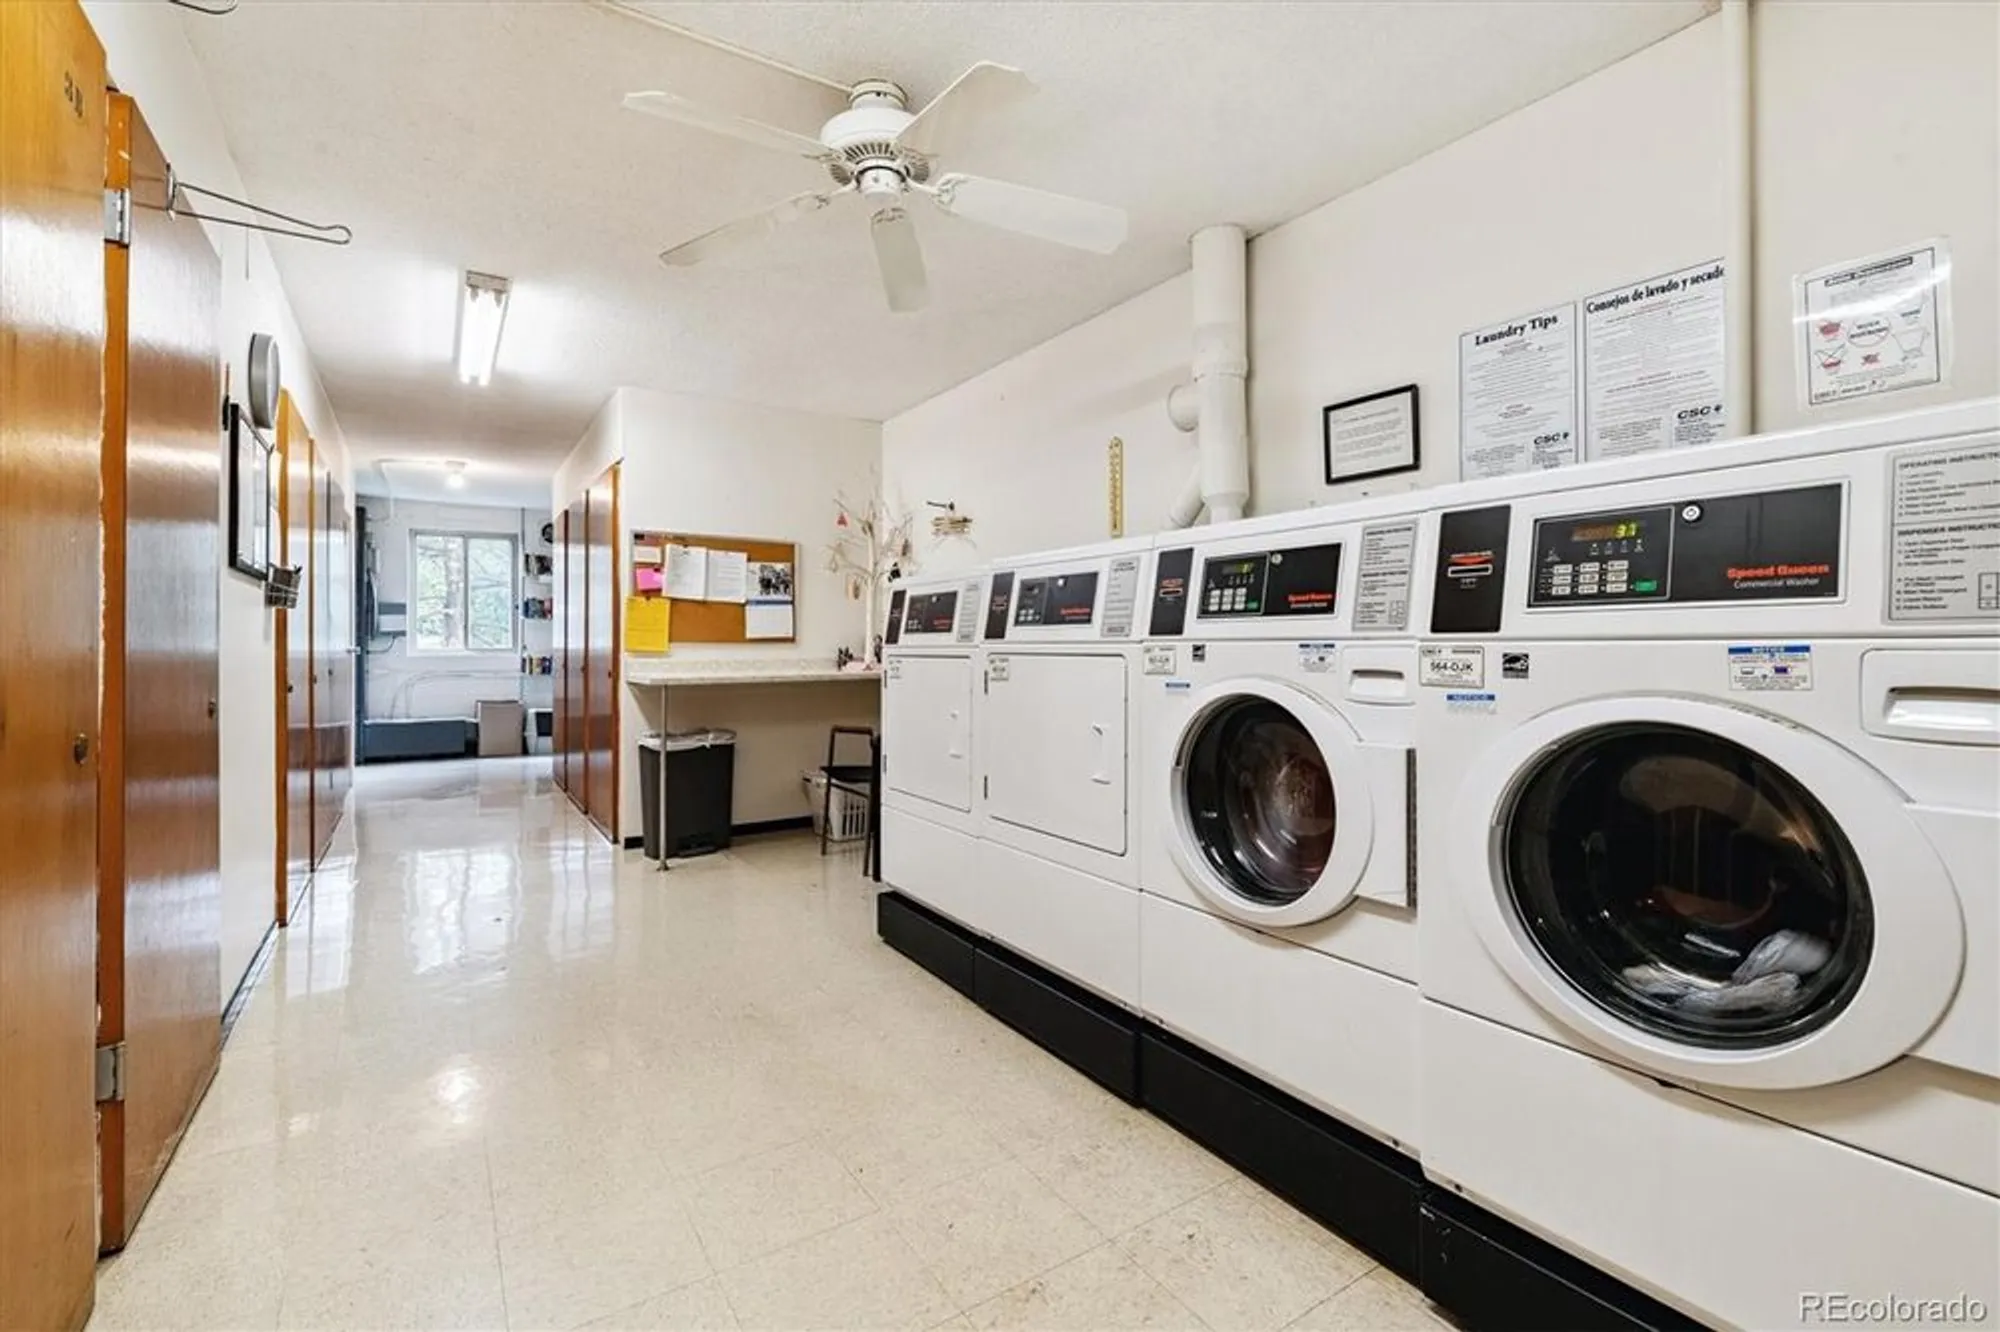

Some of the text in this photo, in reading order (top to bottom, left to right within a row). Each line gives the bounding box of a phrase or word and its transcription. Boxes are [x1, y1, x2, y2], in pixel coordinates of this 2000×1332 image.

[1586, 294, 1630, 314] Consejos
[1631, 290, 1644, 302] de
[1645, 280, 1680, 299] lavado
[1680, 278, 1688, 291] y
[1475, 314, 1558, 346] Laundry Tips
[1677, 405, 1710, 420] CSC
[1534, 432, 1561, 446] CSC
[1727, 564, 1830, 580] Speed Queen
[1734, 577, 1821, 590] Commercial Washer
